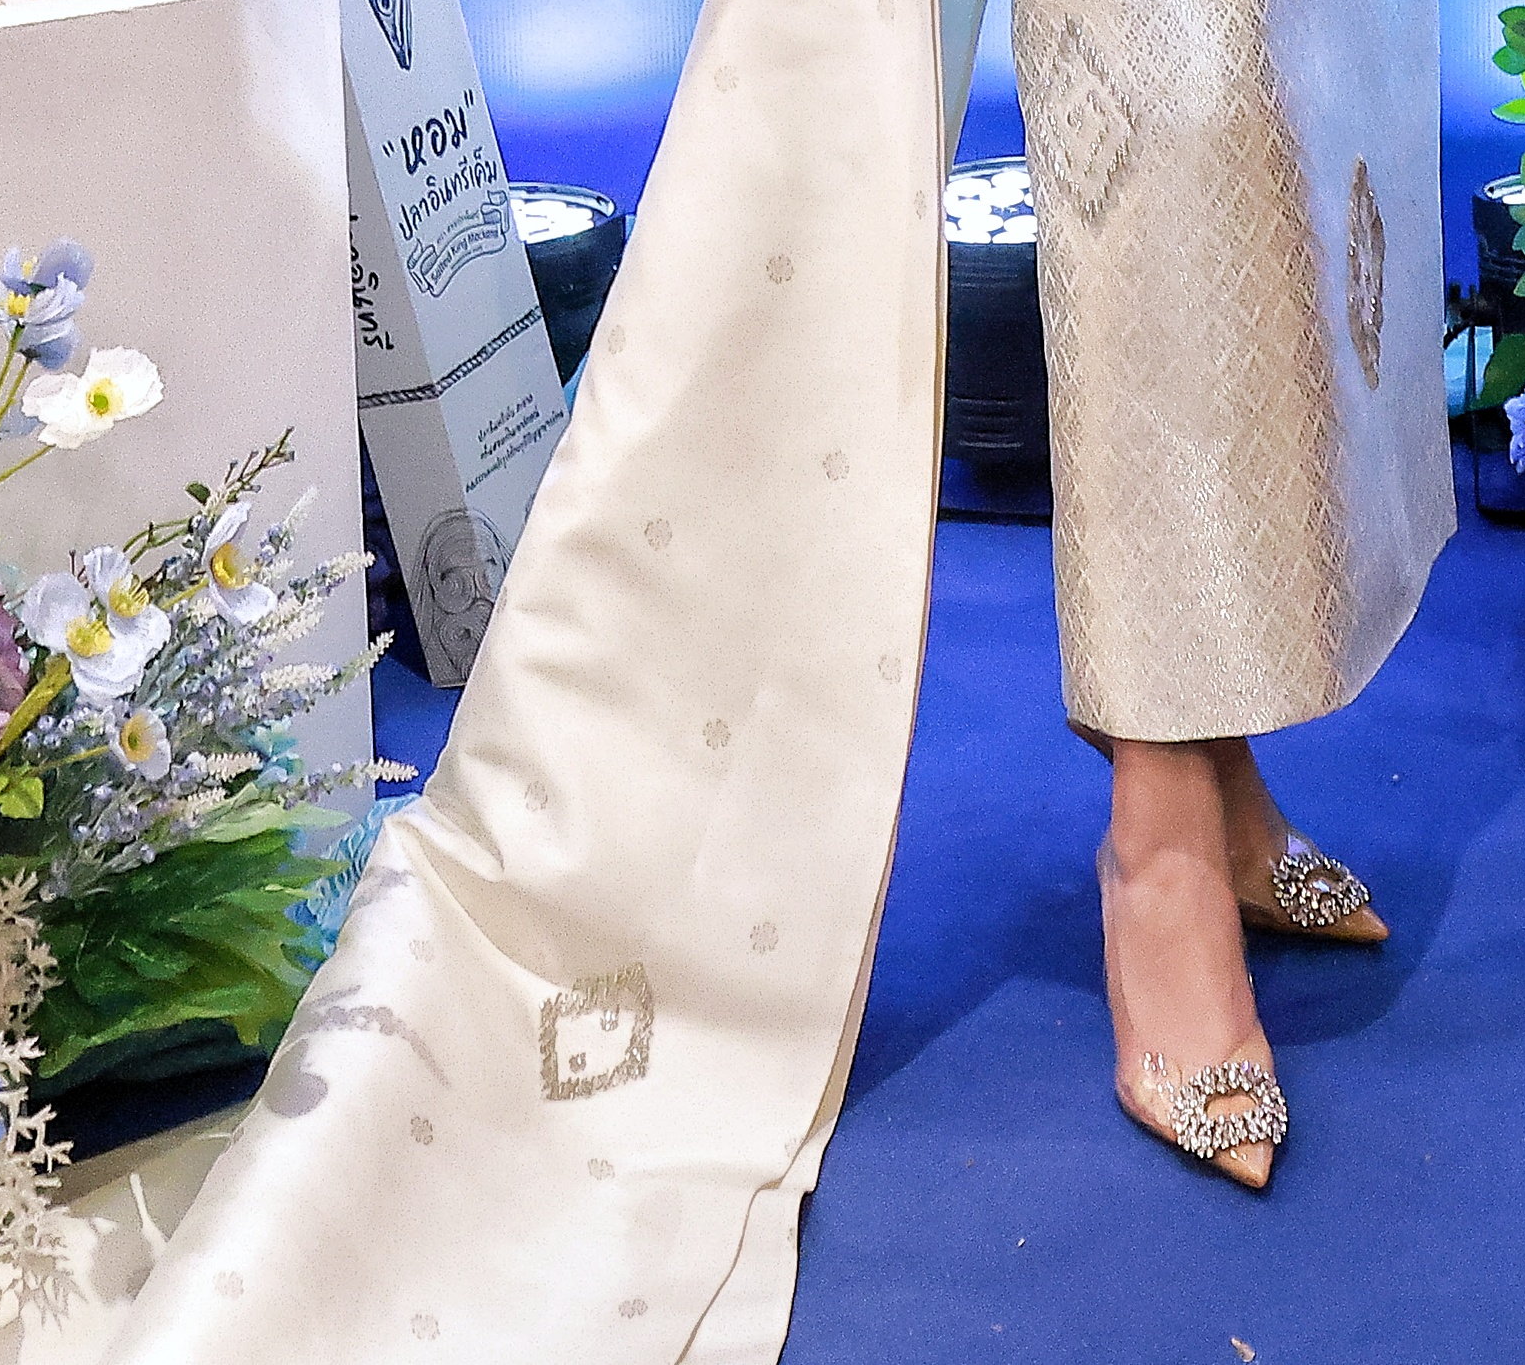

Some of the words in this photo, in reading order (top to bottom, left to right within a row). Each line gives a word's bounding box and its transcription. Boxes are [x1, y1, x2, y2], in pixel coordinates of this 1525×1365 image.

[399, 146, 498, 241] ปลาอินทรีเค็ม
